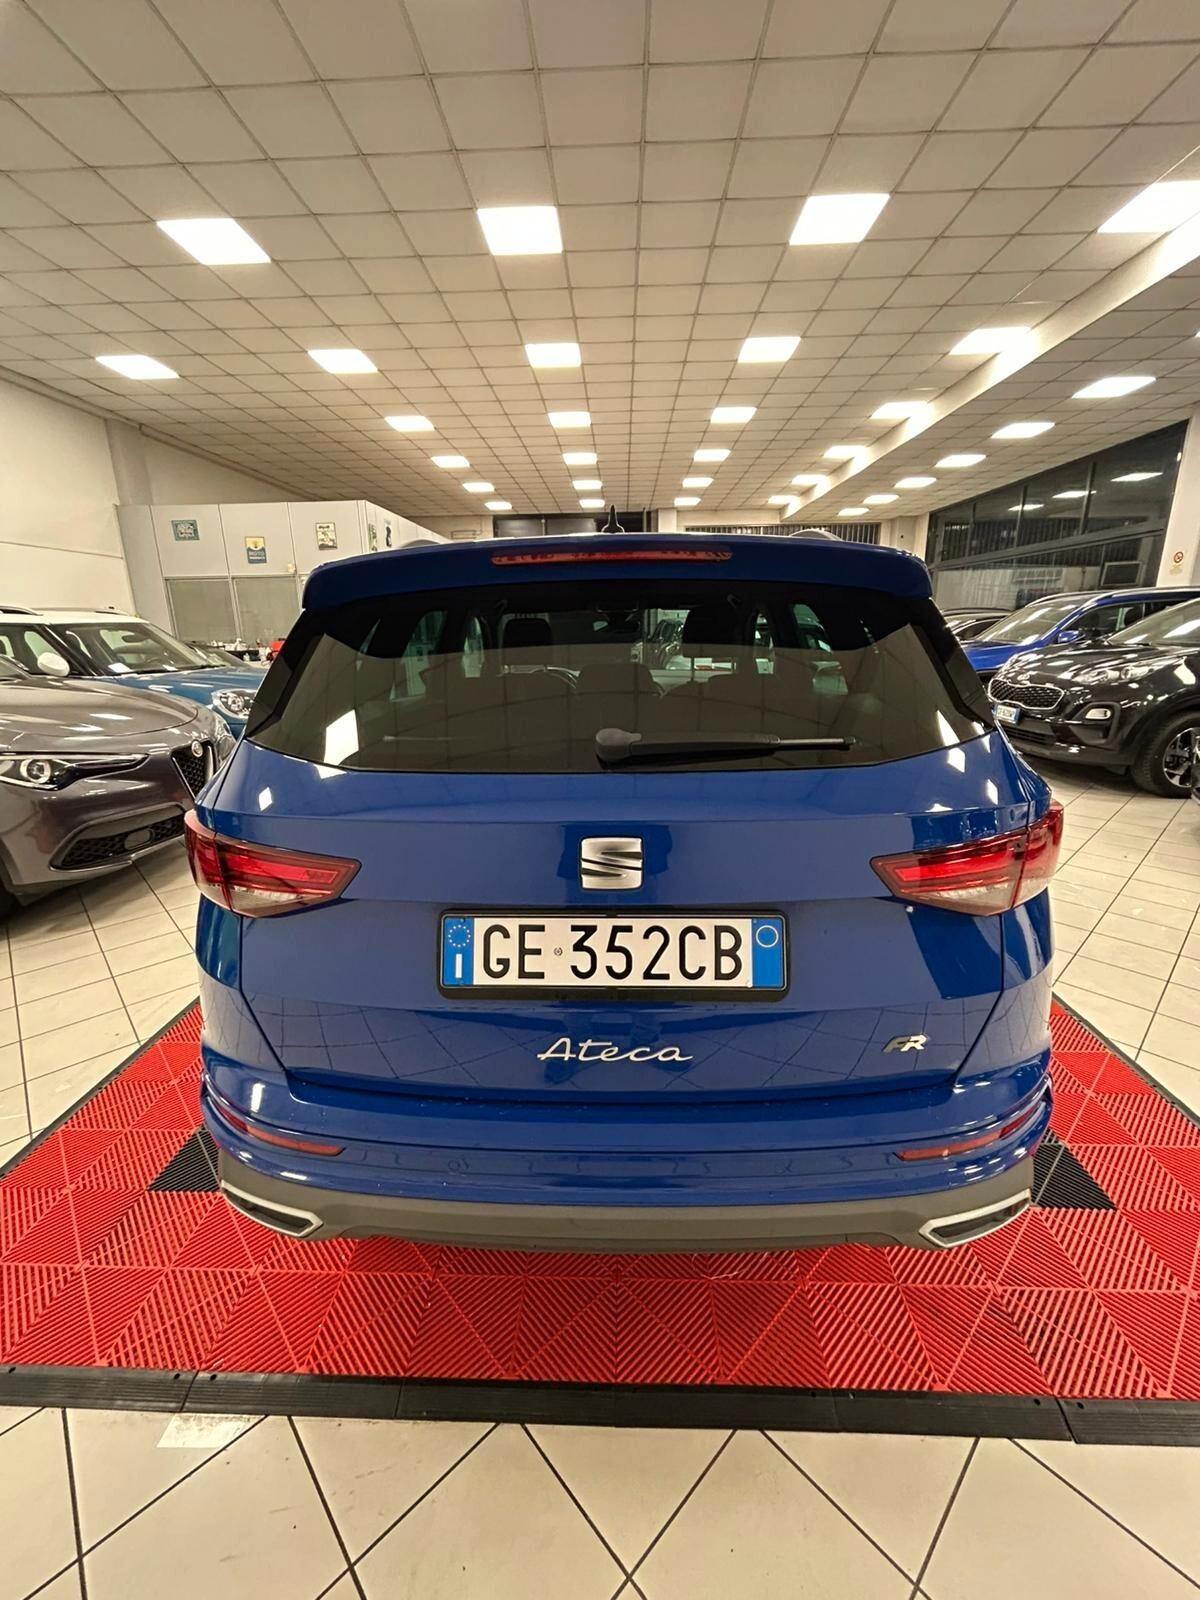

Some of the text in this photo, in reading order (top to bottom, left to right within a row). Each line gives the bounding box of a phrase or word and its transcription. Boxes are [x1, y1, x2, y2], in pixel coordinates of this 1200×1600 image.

[483, 924, 743, 981] GE 352CB
[537, 1037, 694, 1061] Ateca
[883, 1034, 927, 1053] FR
